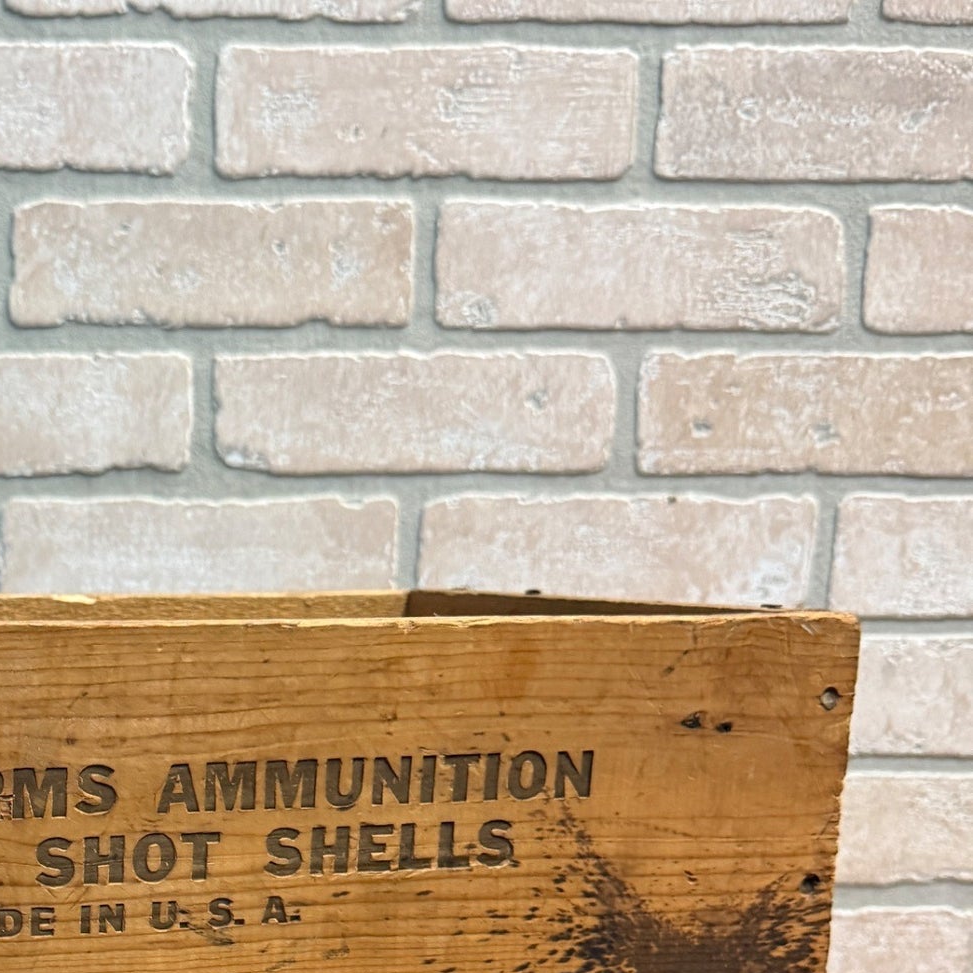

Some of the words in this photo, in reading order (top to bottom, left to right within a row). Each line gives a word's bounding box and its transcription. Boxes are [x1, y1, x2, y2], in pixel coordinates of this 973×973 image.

[157, 750, 594, 814] AMMUNITION
[35, 832, 221, 889] SHOT
[264, 820, 515, 877] SHELLS
[80, 903, 126, 934] IN
